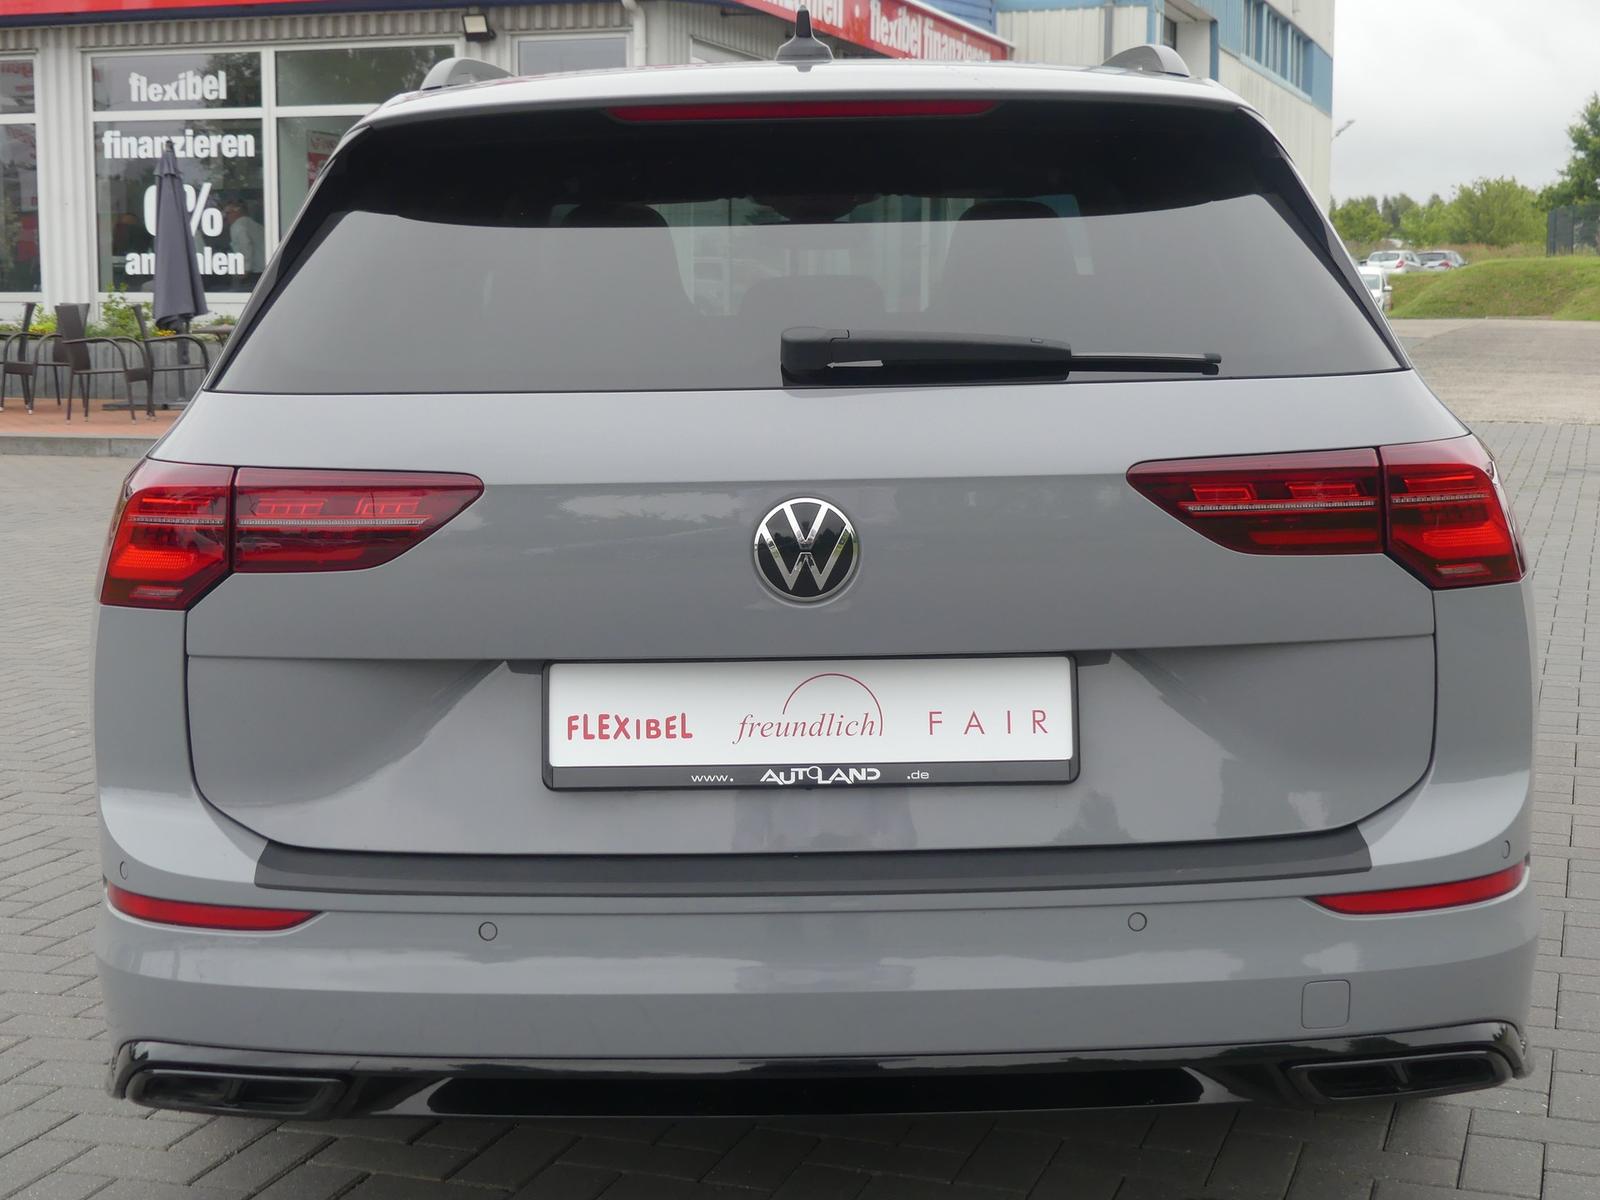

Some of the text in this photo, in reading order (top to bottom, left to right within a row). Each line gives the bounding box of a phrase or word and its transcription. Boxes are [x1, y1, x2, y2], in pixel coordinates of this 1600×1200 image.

[870, 0, 921, 59] flexibel
[923, 17, 991, 60] finanzi
[129, 70, 227, 102] flexibel
[102, 129, 255, 159] finanzieren
[125, 247, 245, 275] anlen
[567, 709, 1048, 744] FLEXIBEL freundlich FAIR
[690, 766, 930, 785] www. AUTOLAND .de
